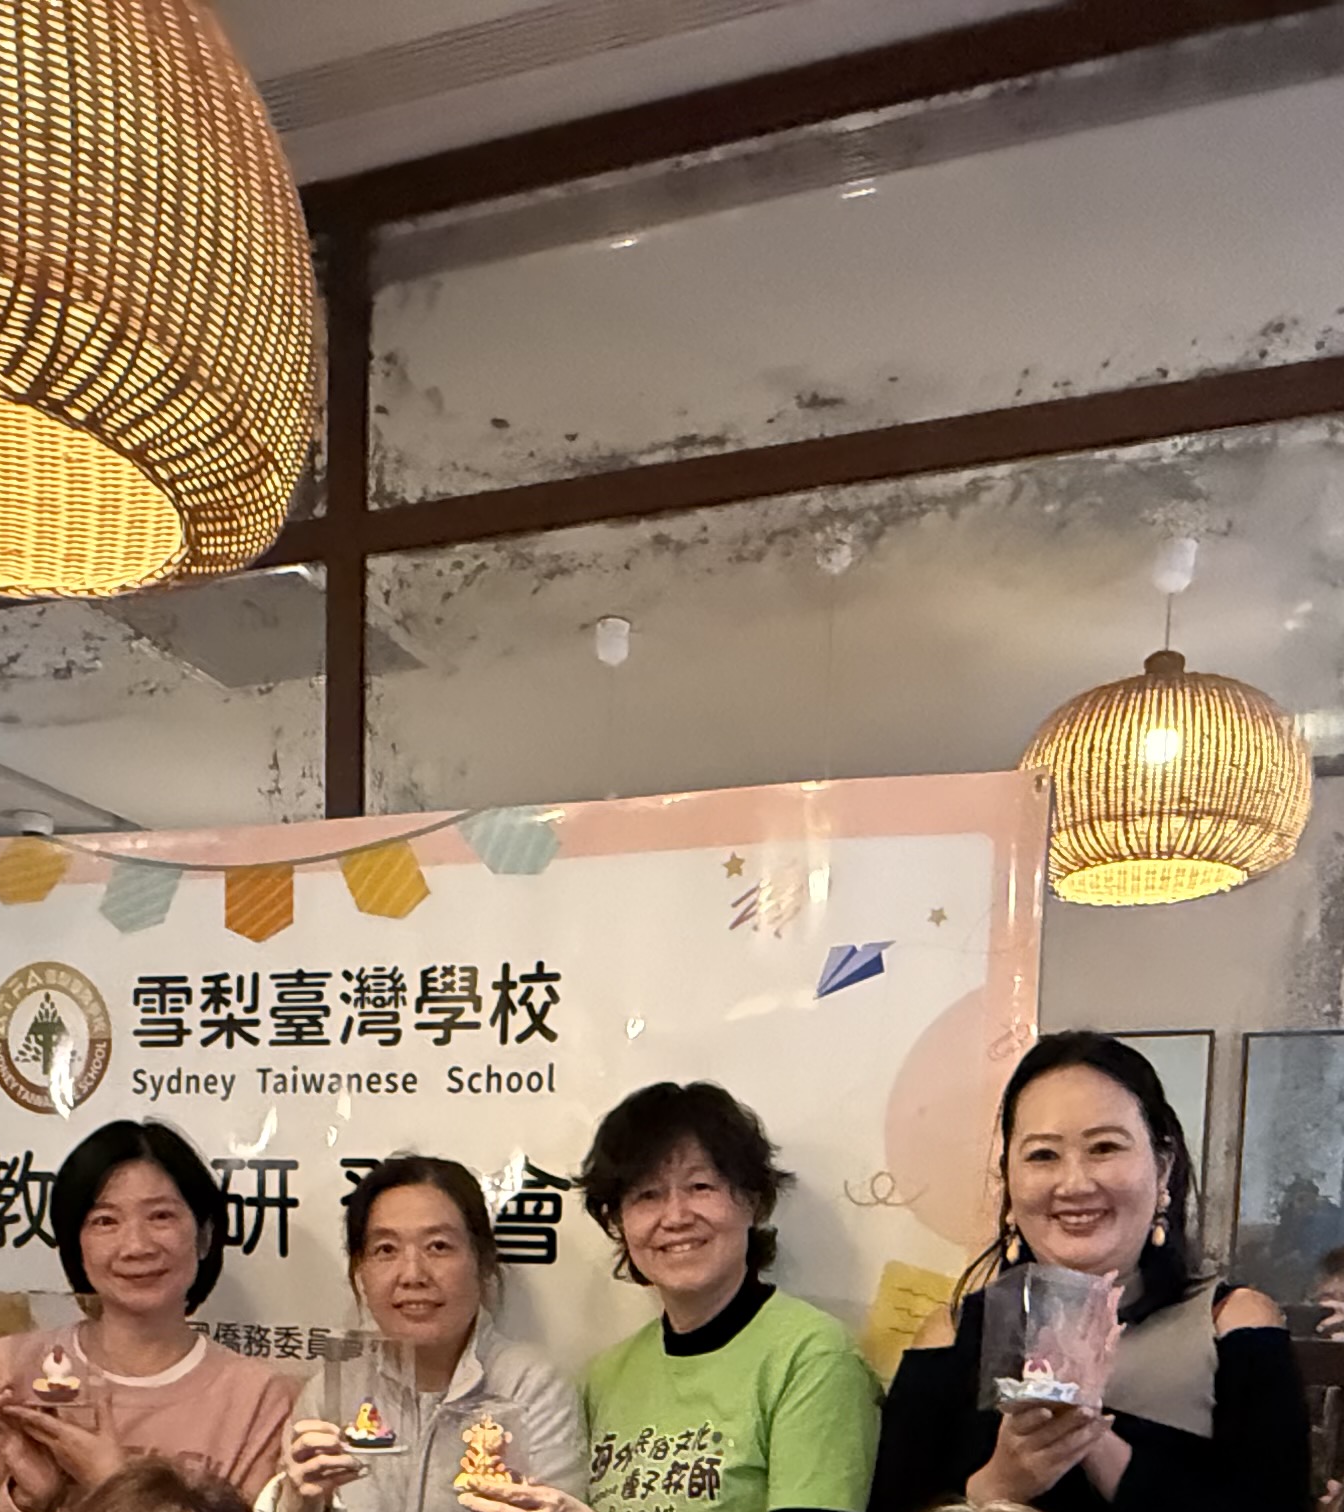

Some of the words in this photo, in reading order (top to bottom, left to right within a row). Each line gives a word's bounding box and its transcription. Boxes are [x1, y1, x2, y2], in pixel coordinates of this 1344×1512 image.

[132, 961, 562, 1049] 雪梨臺灣學校
[132, 1067, 236, 1101] Sydney
[256, 1066, 418, 1094] Taiwanese
[446, 1062, 556, 1094] School
